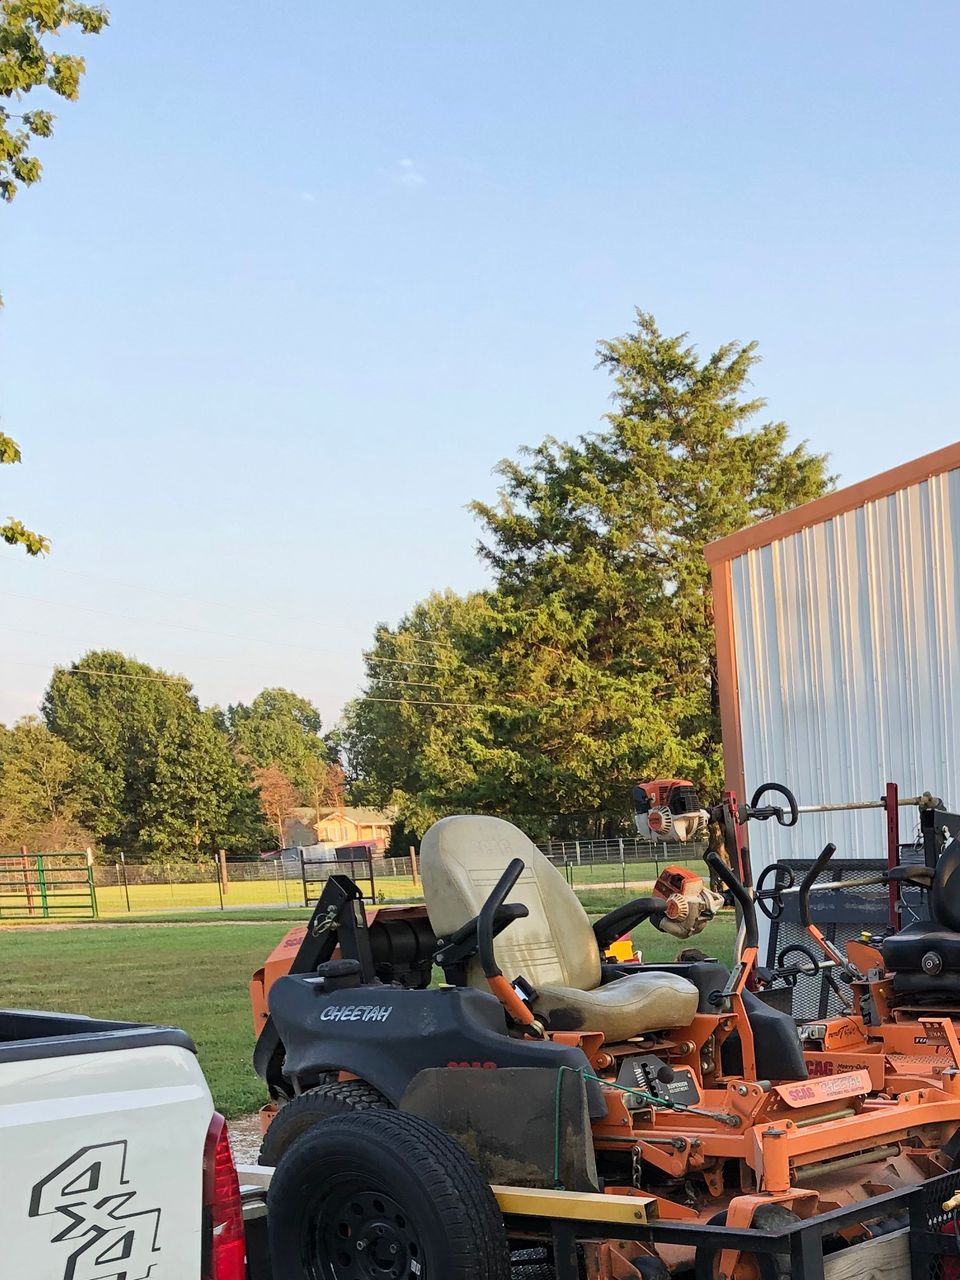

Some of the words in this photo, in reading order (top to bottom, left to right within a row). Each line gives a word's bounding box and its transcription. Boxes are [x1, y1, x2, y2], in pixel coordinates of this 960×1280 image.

[320, 1005, 393, 1022] CHEETAH
[805, 1060, 834, 1076] CAG
[788, 1087, 816, 1101] SCAG
